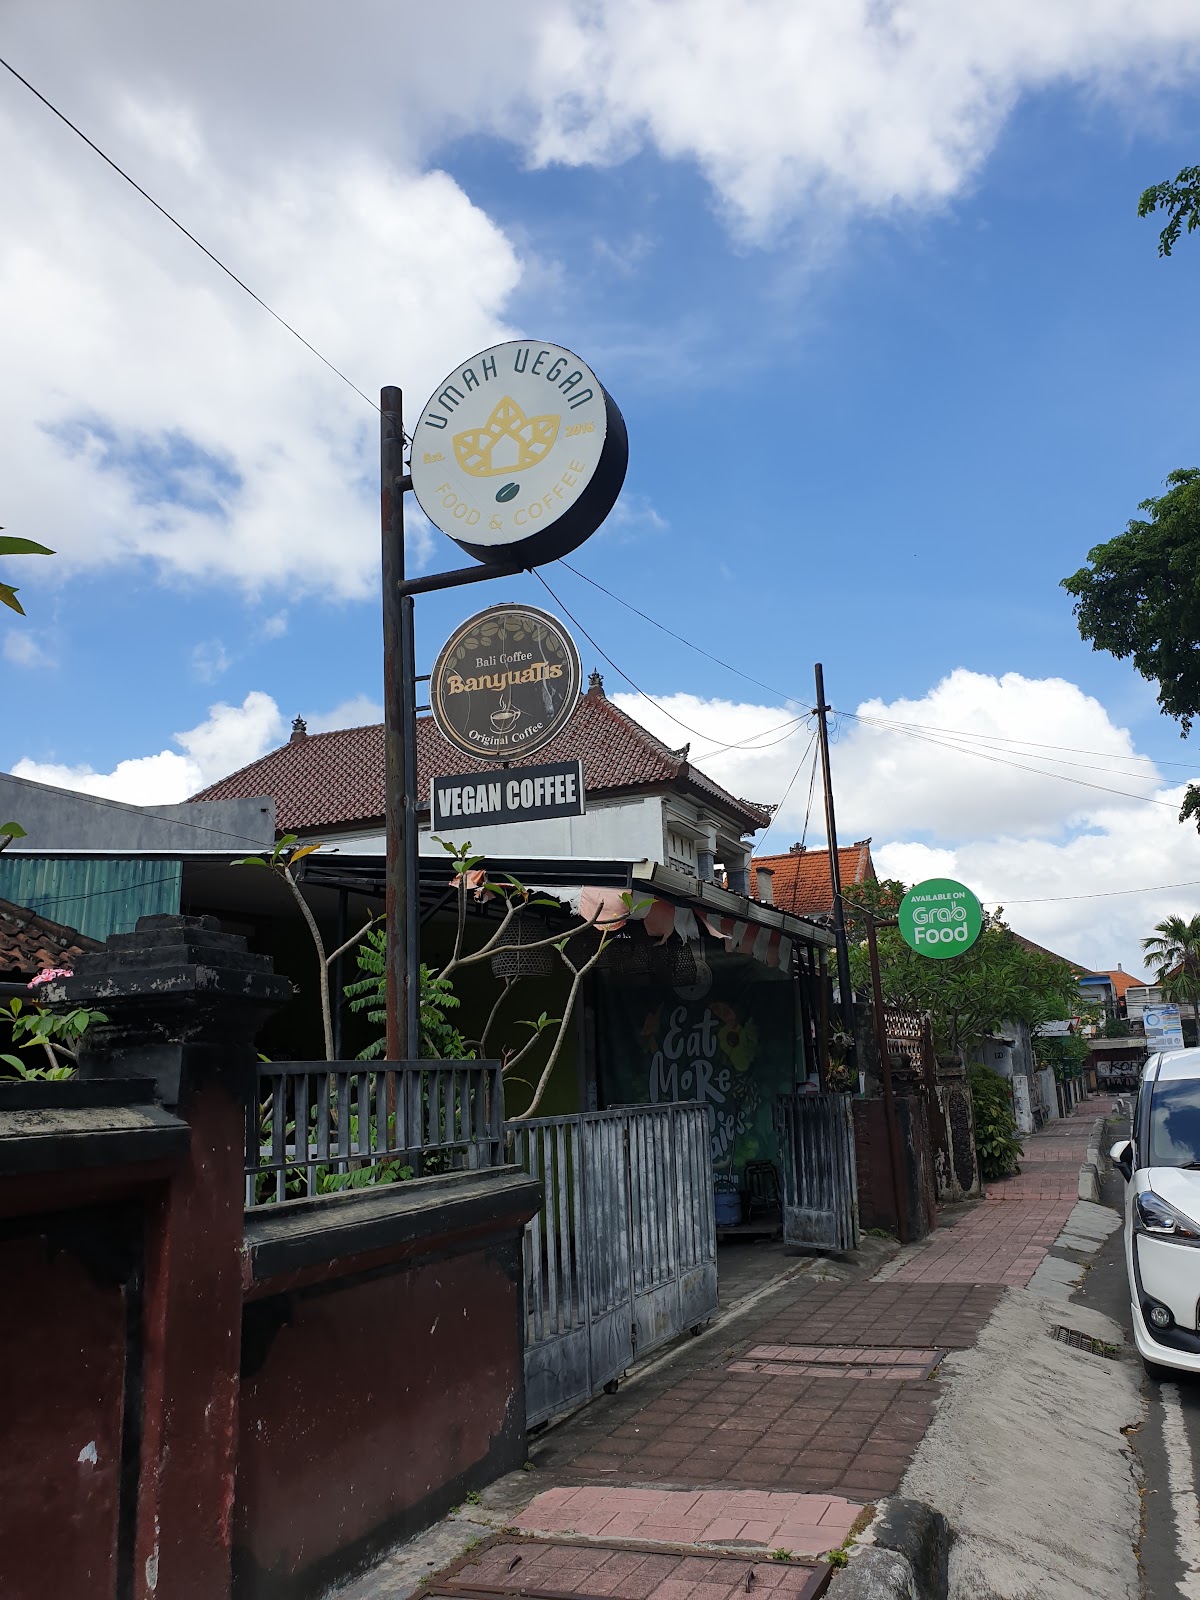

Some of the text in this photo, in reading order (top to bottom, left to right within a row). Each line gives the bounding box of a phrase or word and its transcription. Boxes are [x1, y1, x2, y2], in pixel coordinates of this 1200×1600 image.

[424, 355, 498, 430] UMAH
[434, 459, 586, 529] FOOD & COFFEE
[475, 651, 533, 668] Bali Coffee
[468, 721, 544, 746] Original Coffee
[437, 773, 577, 818] VEGAN COFFEE
[911, 893, 951, 902] AVAILABLE
[912, 901, 967, 925] Grab
[914, 922, 968, 944] Food
[662, 1005, 720, 1060] Eat
